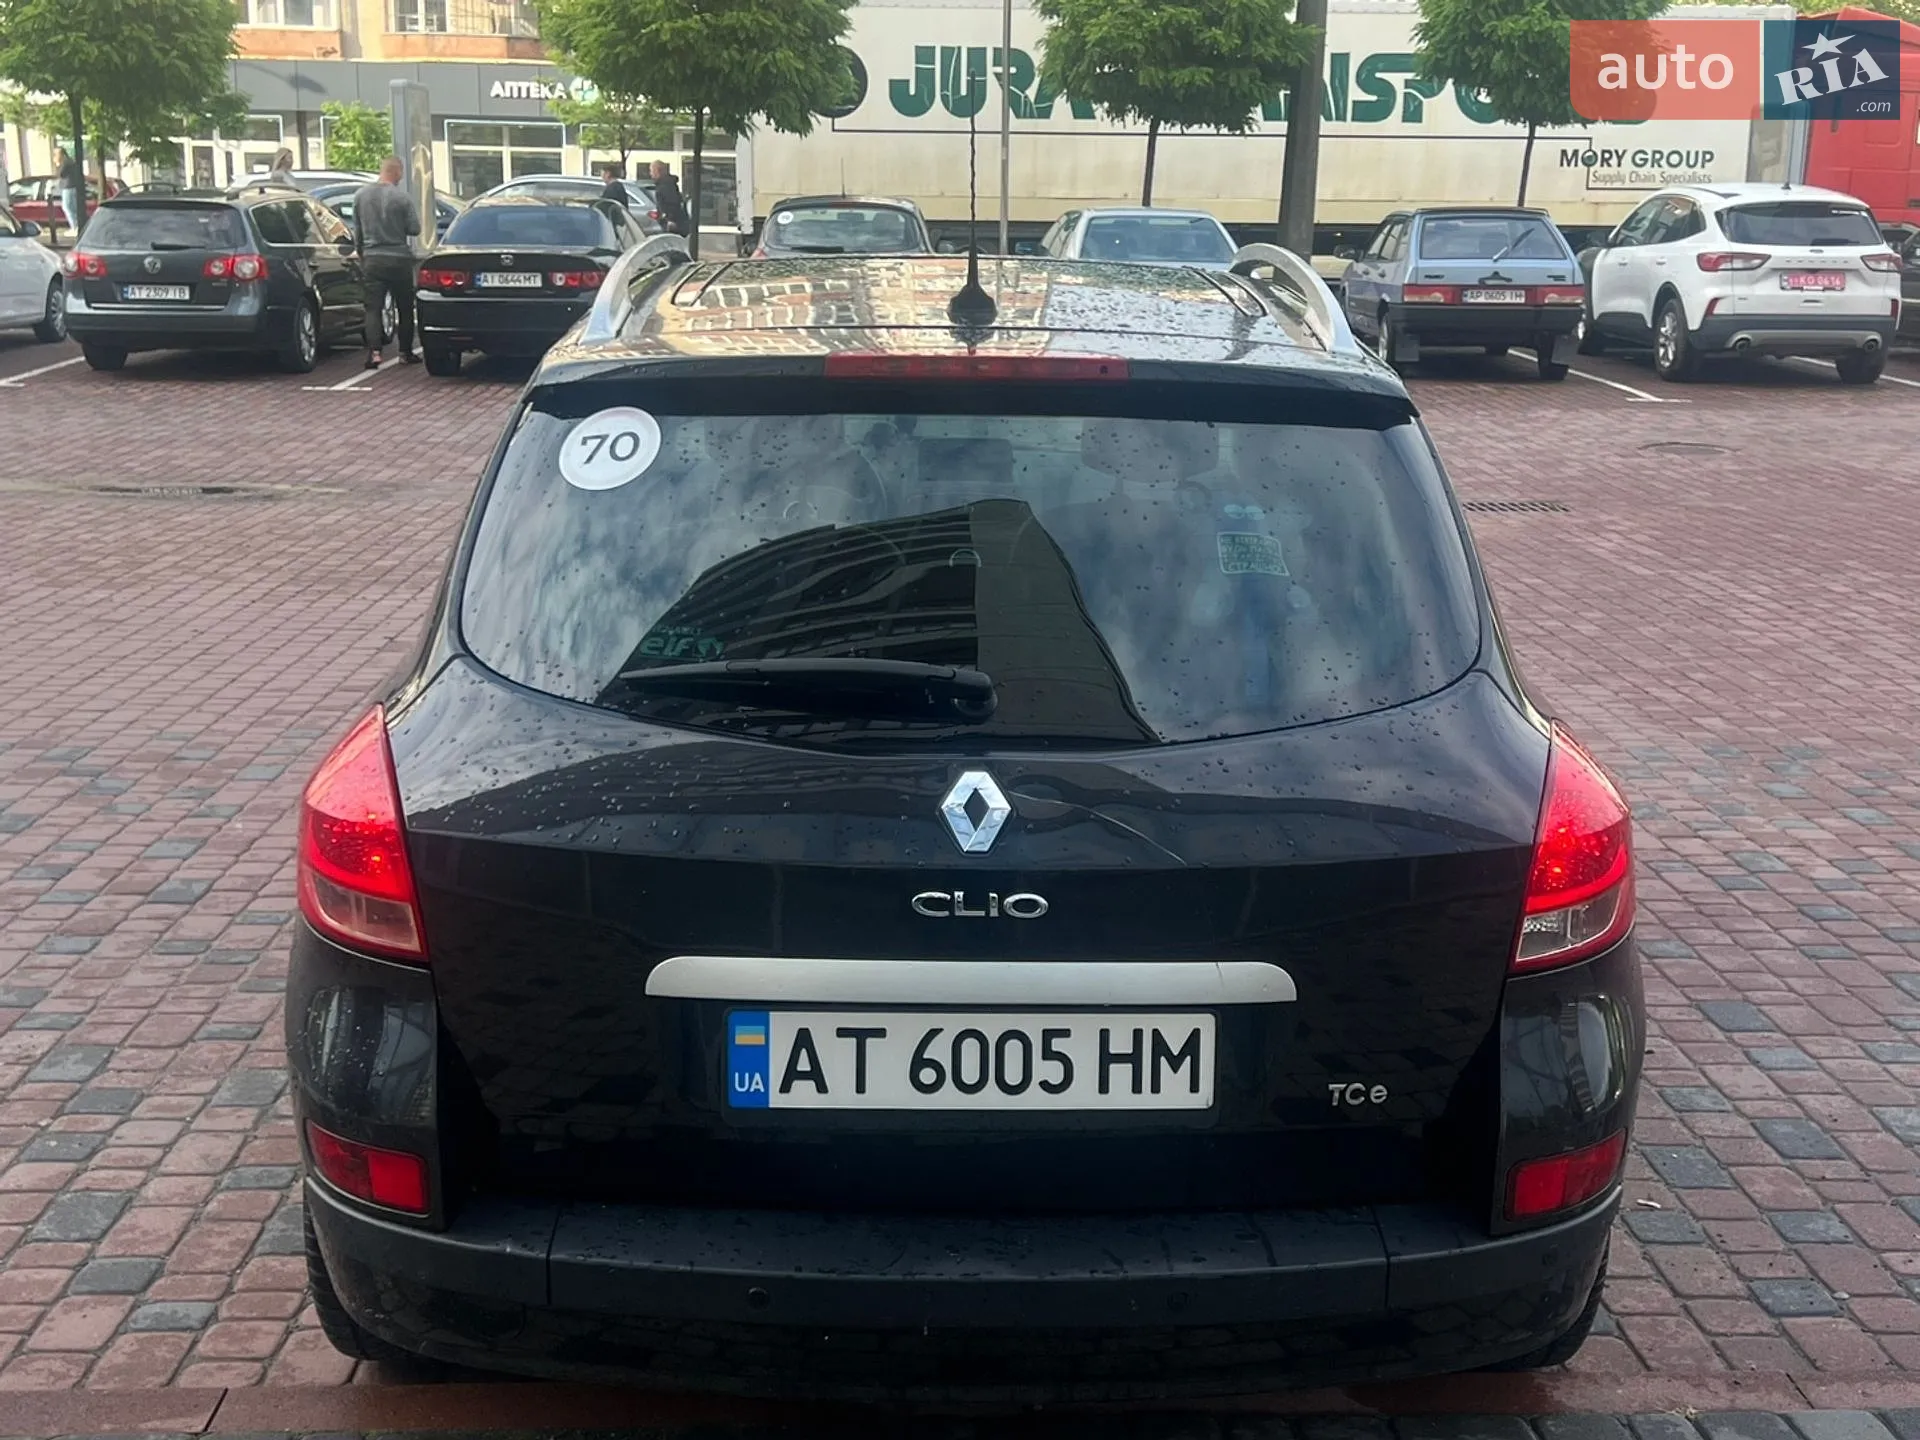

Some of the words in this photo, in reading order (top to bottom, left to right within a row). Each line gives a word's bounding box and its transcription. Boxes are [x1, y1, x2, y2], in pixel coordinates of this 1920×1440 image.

[490, 80, 567, 99] АПТЕКА
[1559, 149, 1627, 168] MORY
[1631, 149, 1715, 169] GROUP
[1591, 170, 1626, 184] Supply
[1629, 170, 1656, 184] Chain
[1659, 171, 1713, 185] Specialists
[580, 430, 641, 465] 70
[911, 890, 1049, 919] CLIO
[778, 1027, 888, 1095] AT
[908, 1027, 1075, 1096] 6005
[1098, 1027, 1202, 1095] HM
[734, 1072, 765, 1092] UA
[1327, 1082, 1389, 1107] TCe
